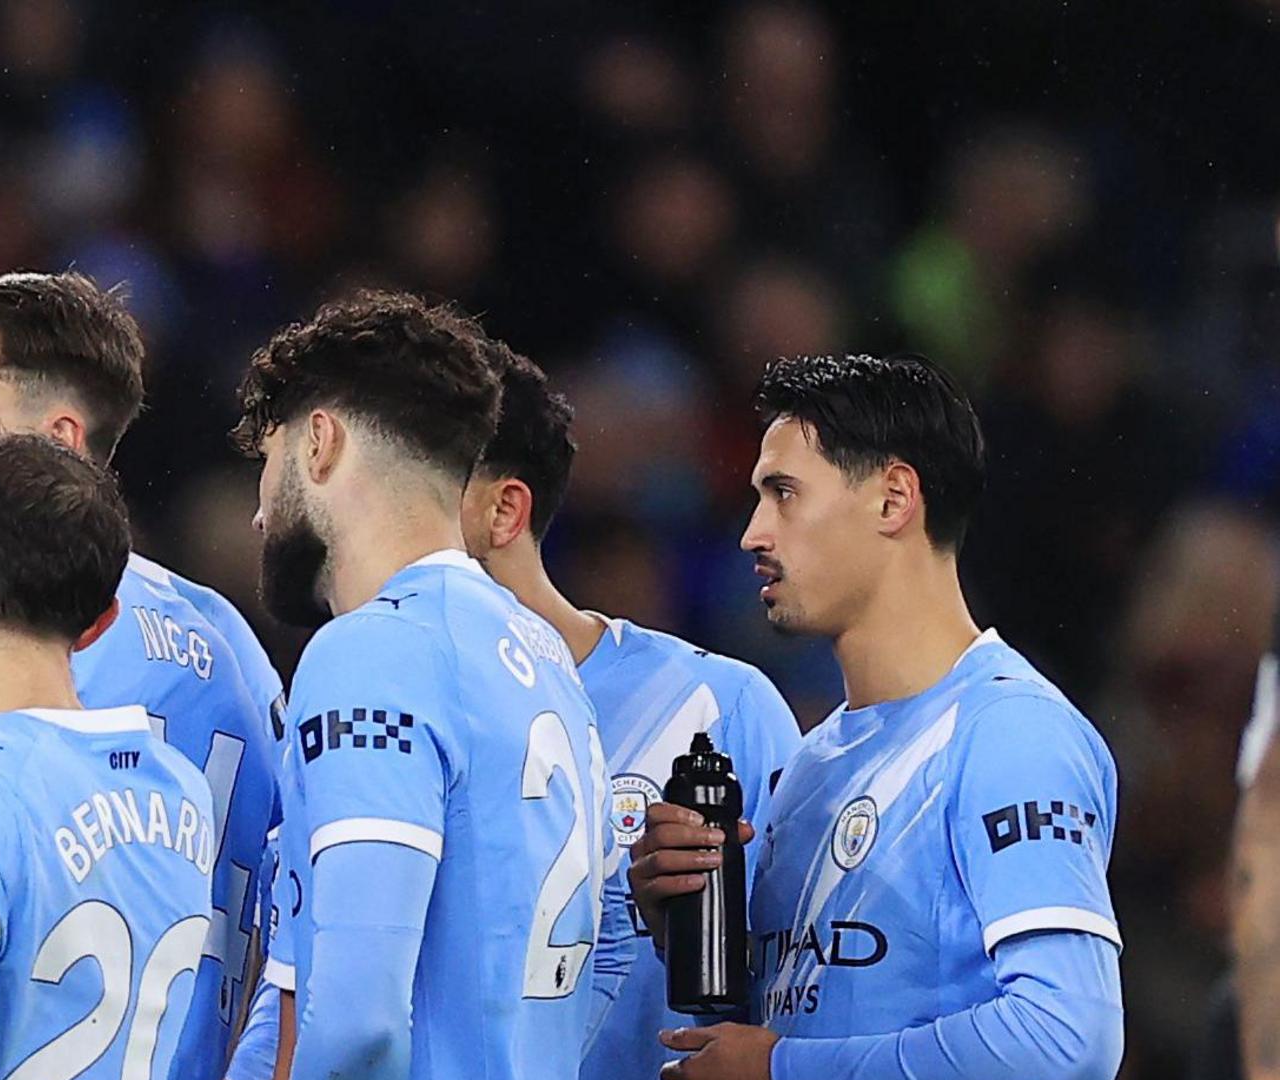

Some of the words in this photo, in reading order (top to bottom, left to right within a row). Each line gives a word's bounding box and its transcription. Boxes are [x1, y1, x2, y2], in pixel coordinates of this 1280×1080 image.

[132, 606, 213, 680] NICO
[109, 751, 141, 770] CITY
[298, 707, 415, 765] OKX
[521, 711, 608, 1000] 2
